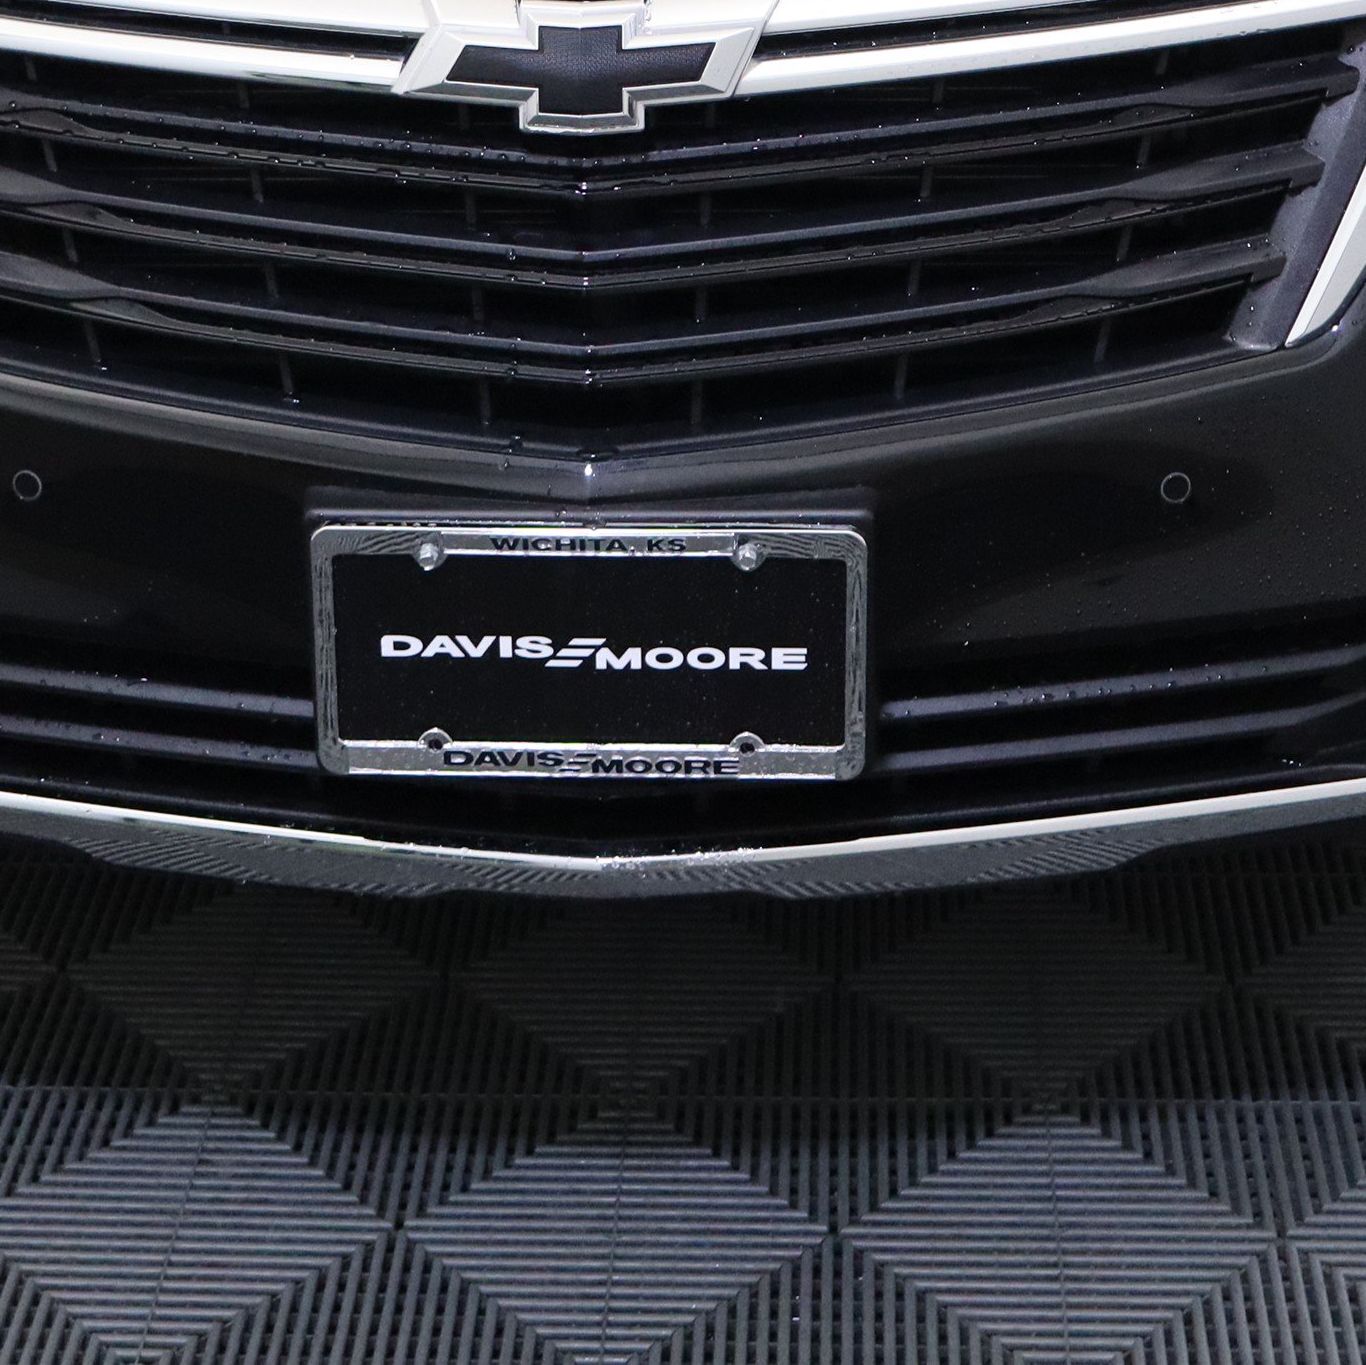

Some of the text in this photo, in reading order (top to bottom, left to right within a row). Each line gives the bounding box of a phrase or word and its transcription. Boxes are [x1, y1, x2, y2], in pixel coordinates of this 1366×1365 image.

[647, 537, 686, 552] KS
[380, 635, 808, 670] DAVIS MOORE
[442, 750, 739, 775] DAVIS MOORE
